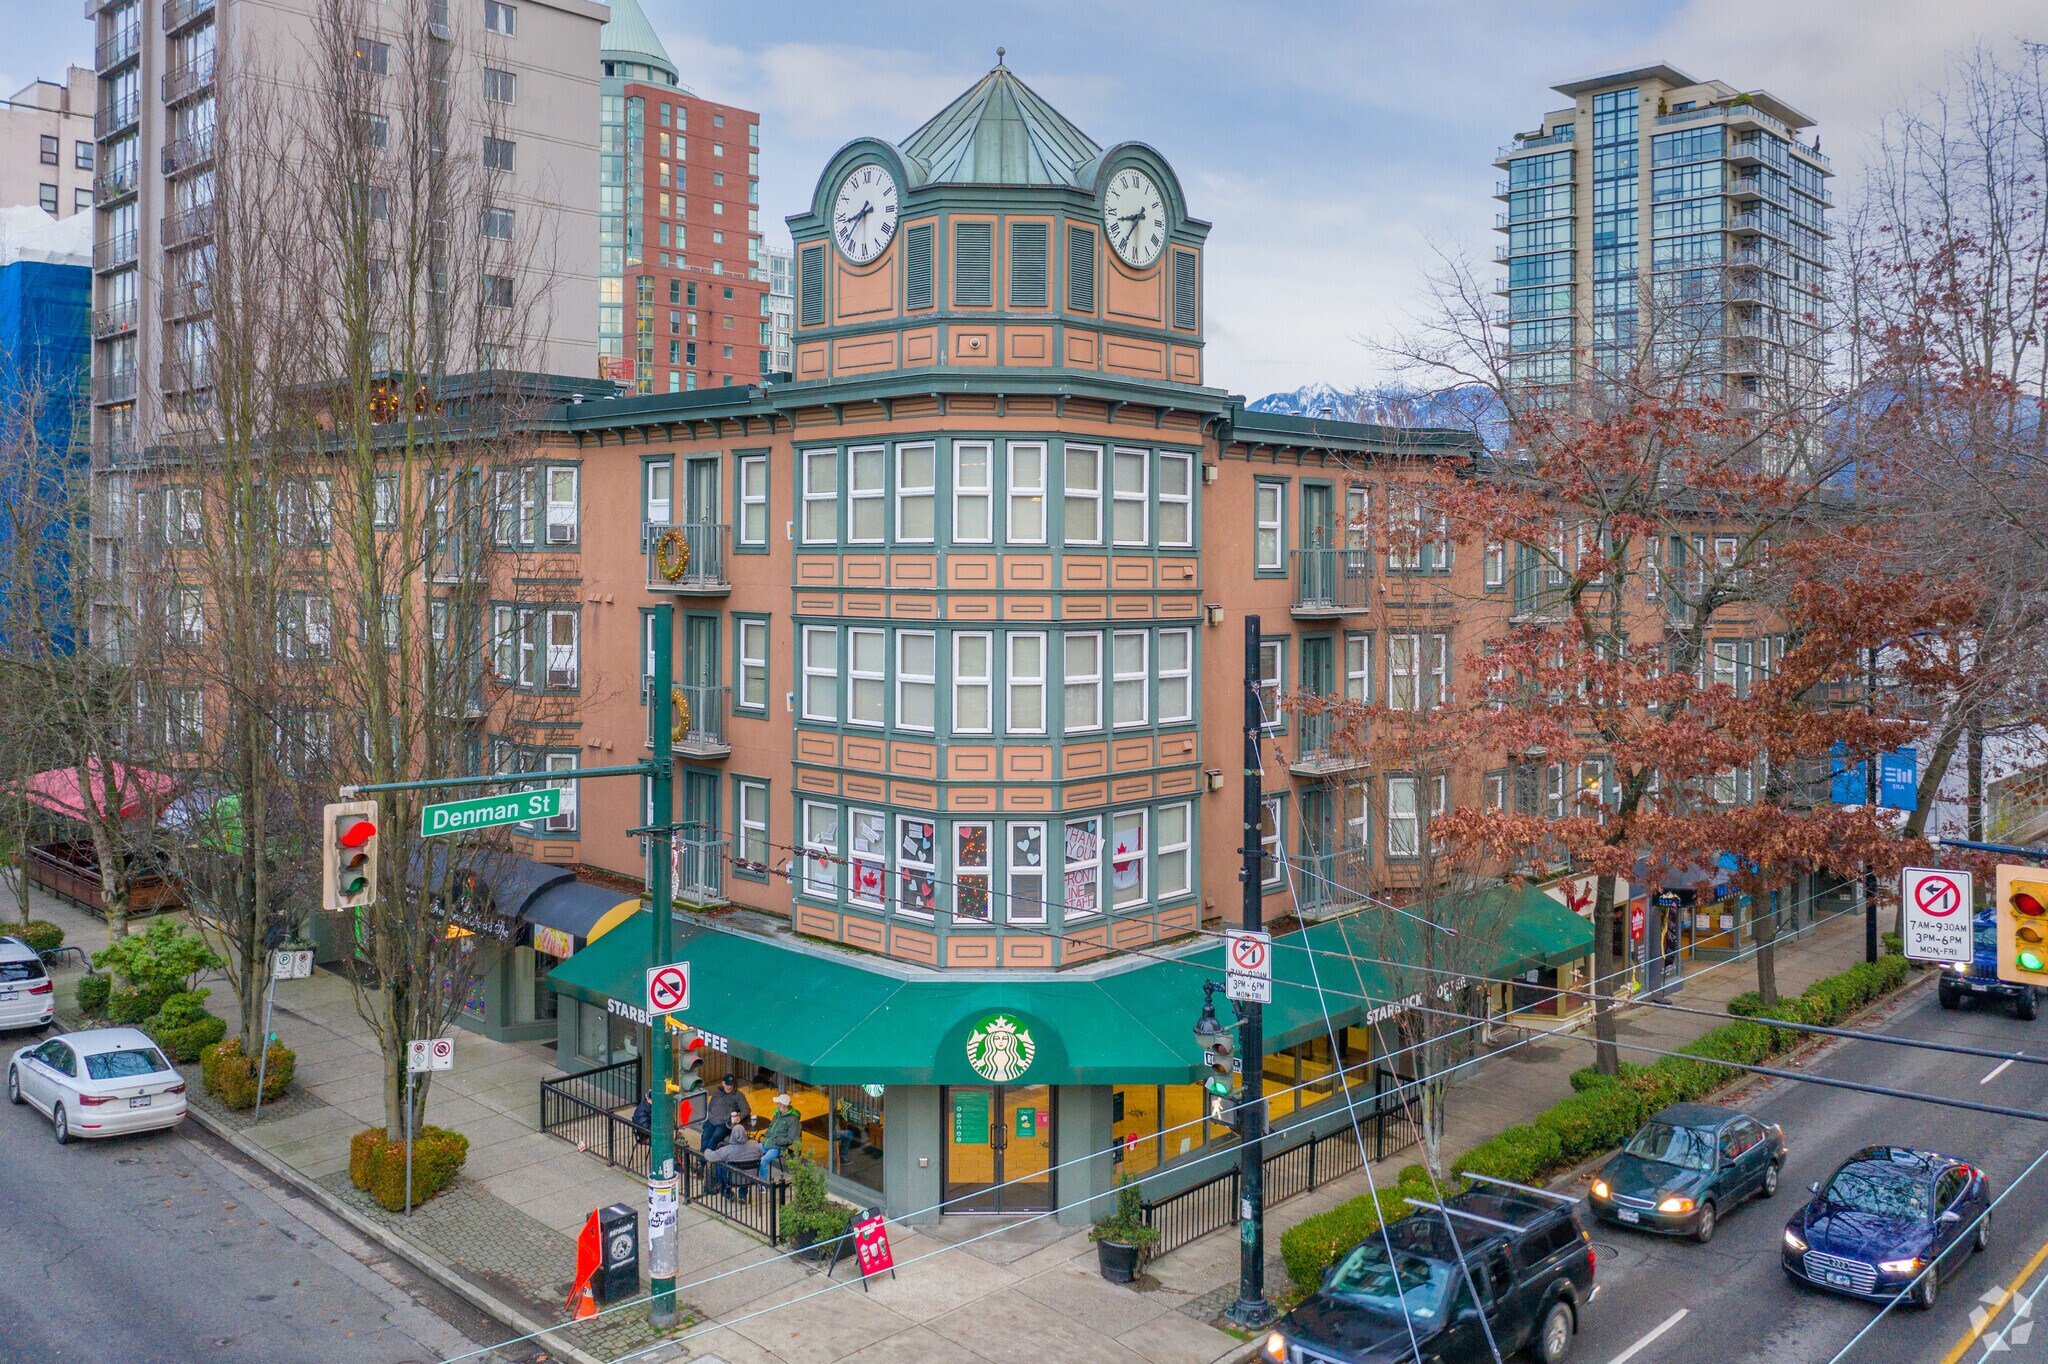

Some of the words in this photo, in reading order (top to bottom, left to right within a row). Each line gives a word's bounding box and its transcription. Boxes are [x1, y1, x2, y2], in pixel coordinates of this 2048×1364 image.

[433, 803, 519, 830] Denman
[528, 795, 550, 815] St
[1069, 842, 1092, 861] YOU
[1068, 884, 1085, 899] INE
[1366, 992, 1423, 1025] STARBUCK
[689, 1026, 728, 1053] FFEE
